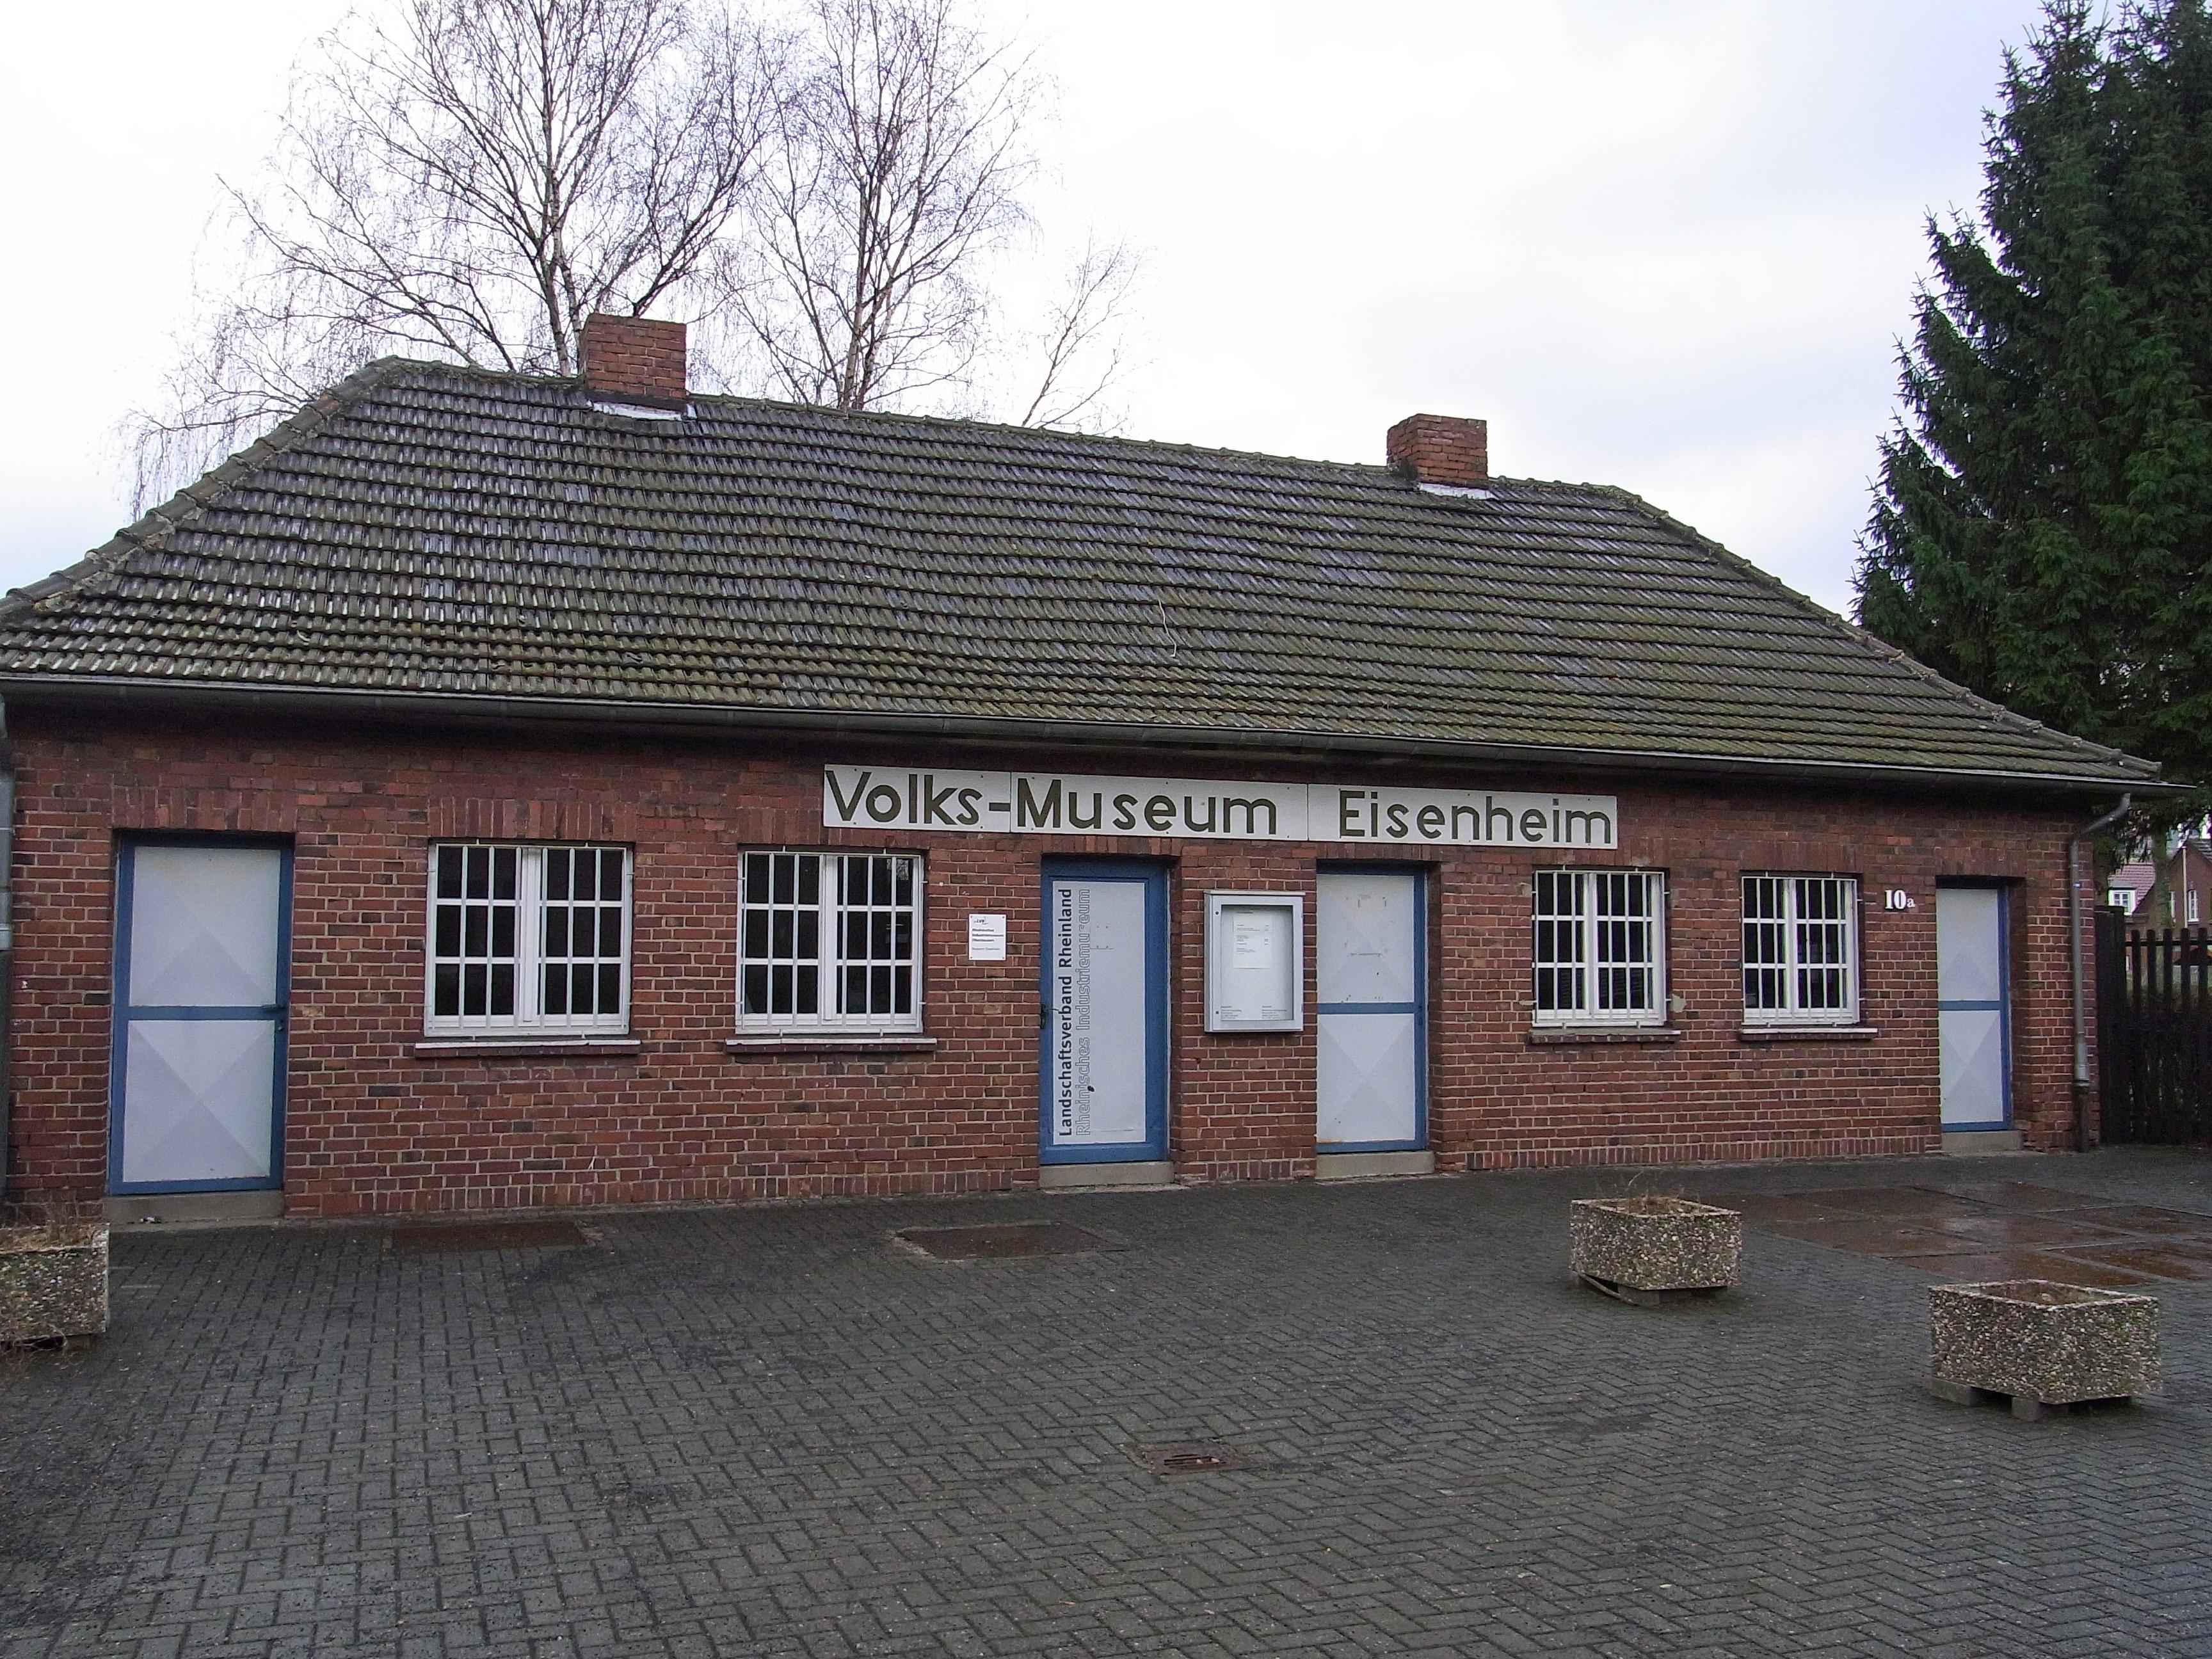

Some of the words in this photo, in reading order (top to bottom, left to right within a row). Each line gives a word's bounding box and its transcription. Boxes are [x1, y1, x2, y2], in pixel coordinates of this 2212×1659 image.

[826, 770, 1277, 835] Volks-Museum
[1340, 790, 1612, 844] Eisenheim
[1058, 888, 1073, 968] Rheinland
[1884, 889, 1916, 910] 10a
[1058, 975, 1073, 1137] Landschaftsverband
[1075, 1037, 1091, 1136] Rheinisches
